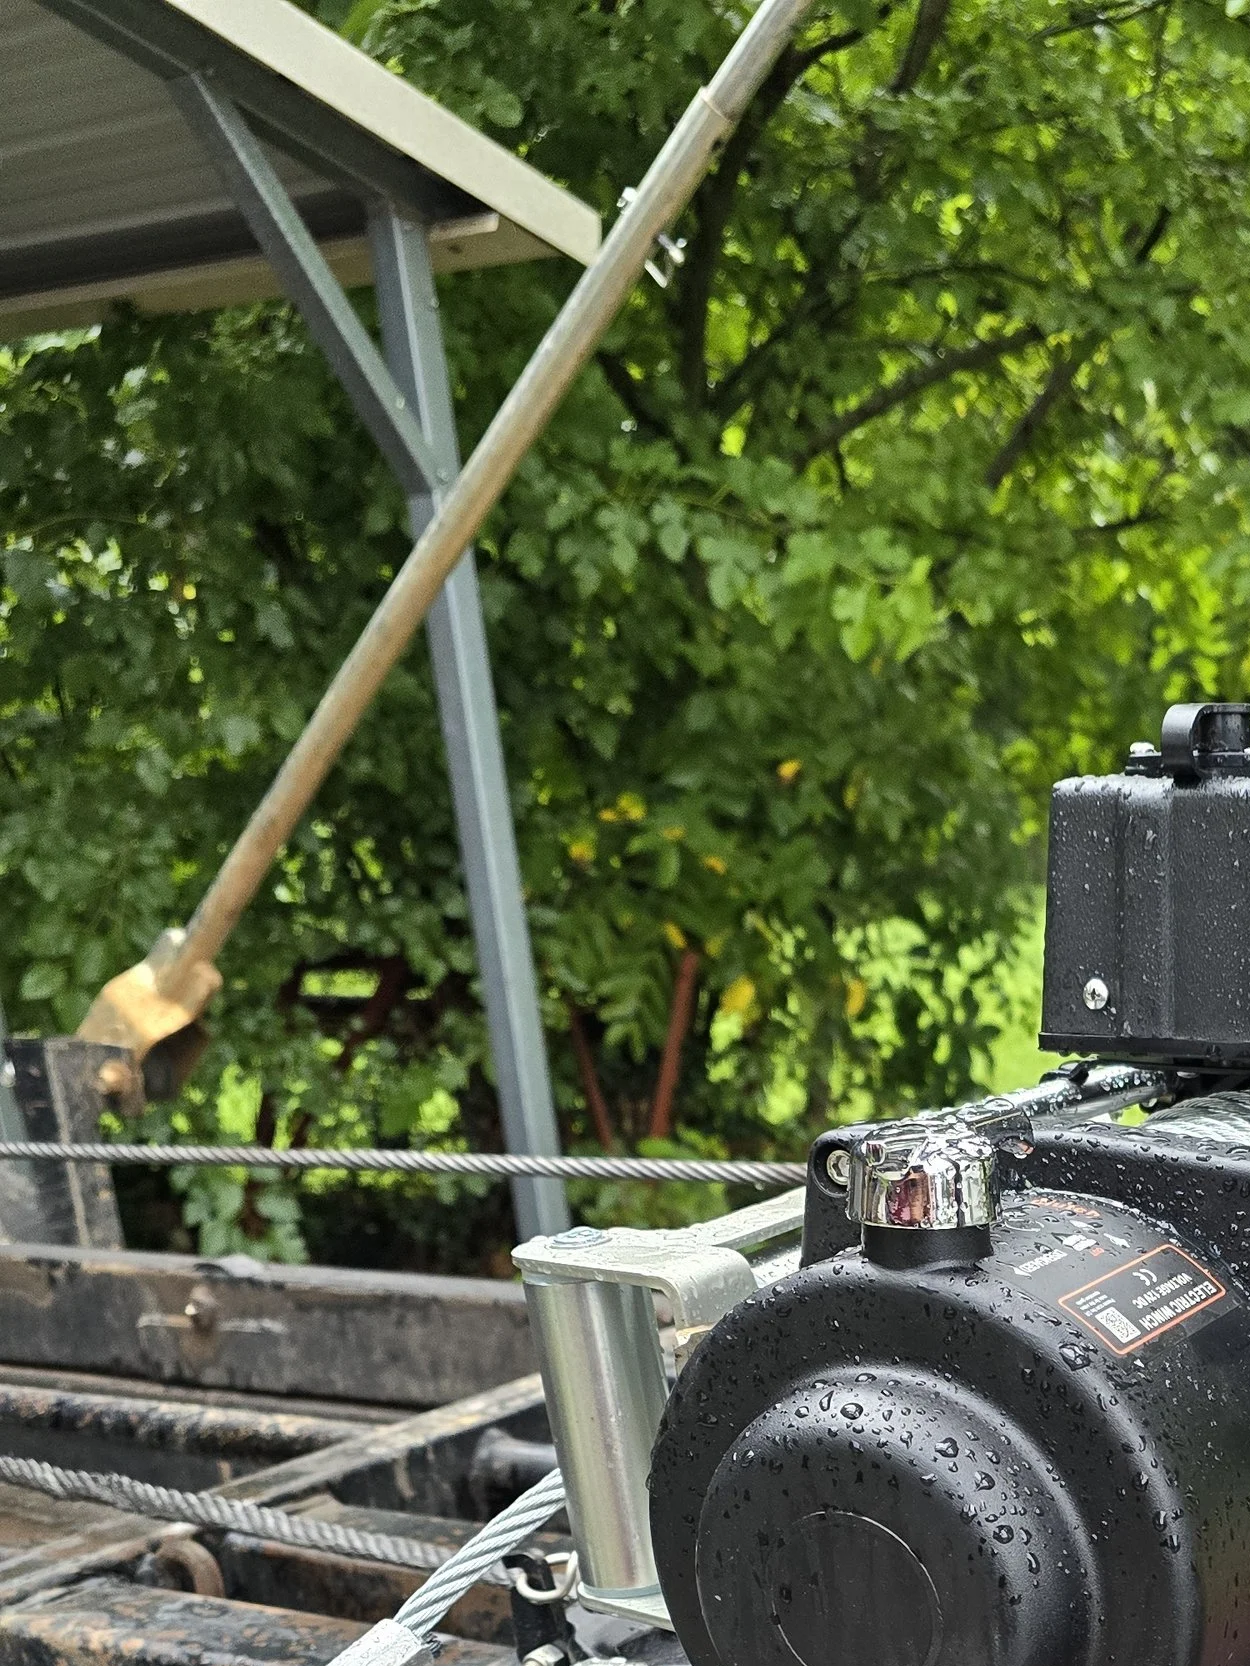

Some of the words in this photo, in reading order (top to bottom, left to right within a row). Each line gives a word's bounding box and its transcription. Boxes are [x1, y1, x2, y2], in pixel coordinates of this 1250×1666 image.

[1155, 1273, 1192, 1296] VOLTAGE
[1132, 1296, 1149, 1308] DC
[1169, 1281, 1217, 1313] ELECTRIC
[1139, 1306, 1177, 1331] WINCH
